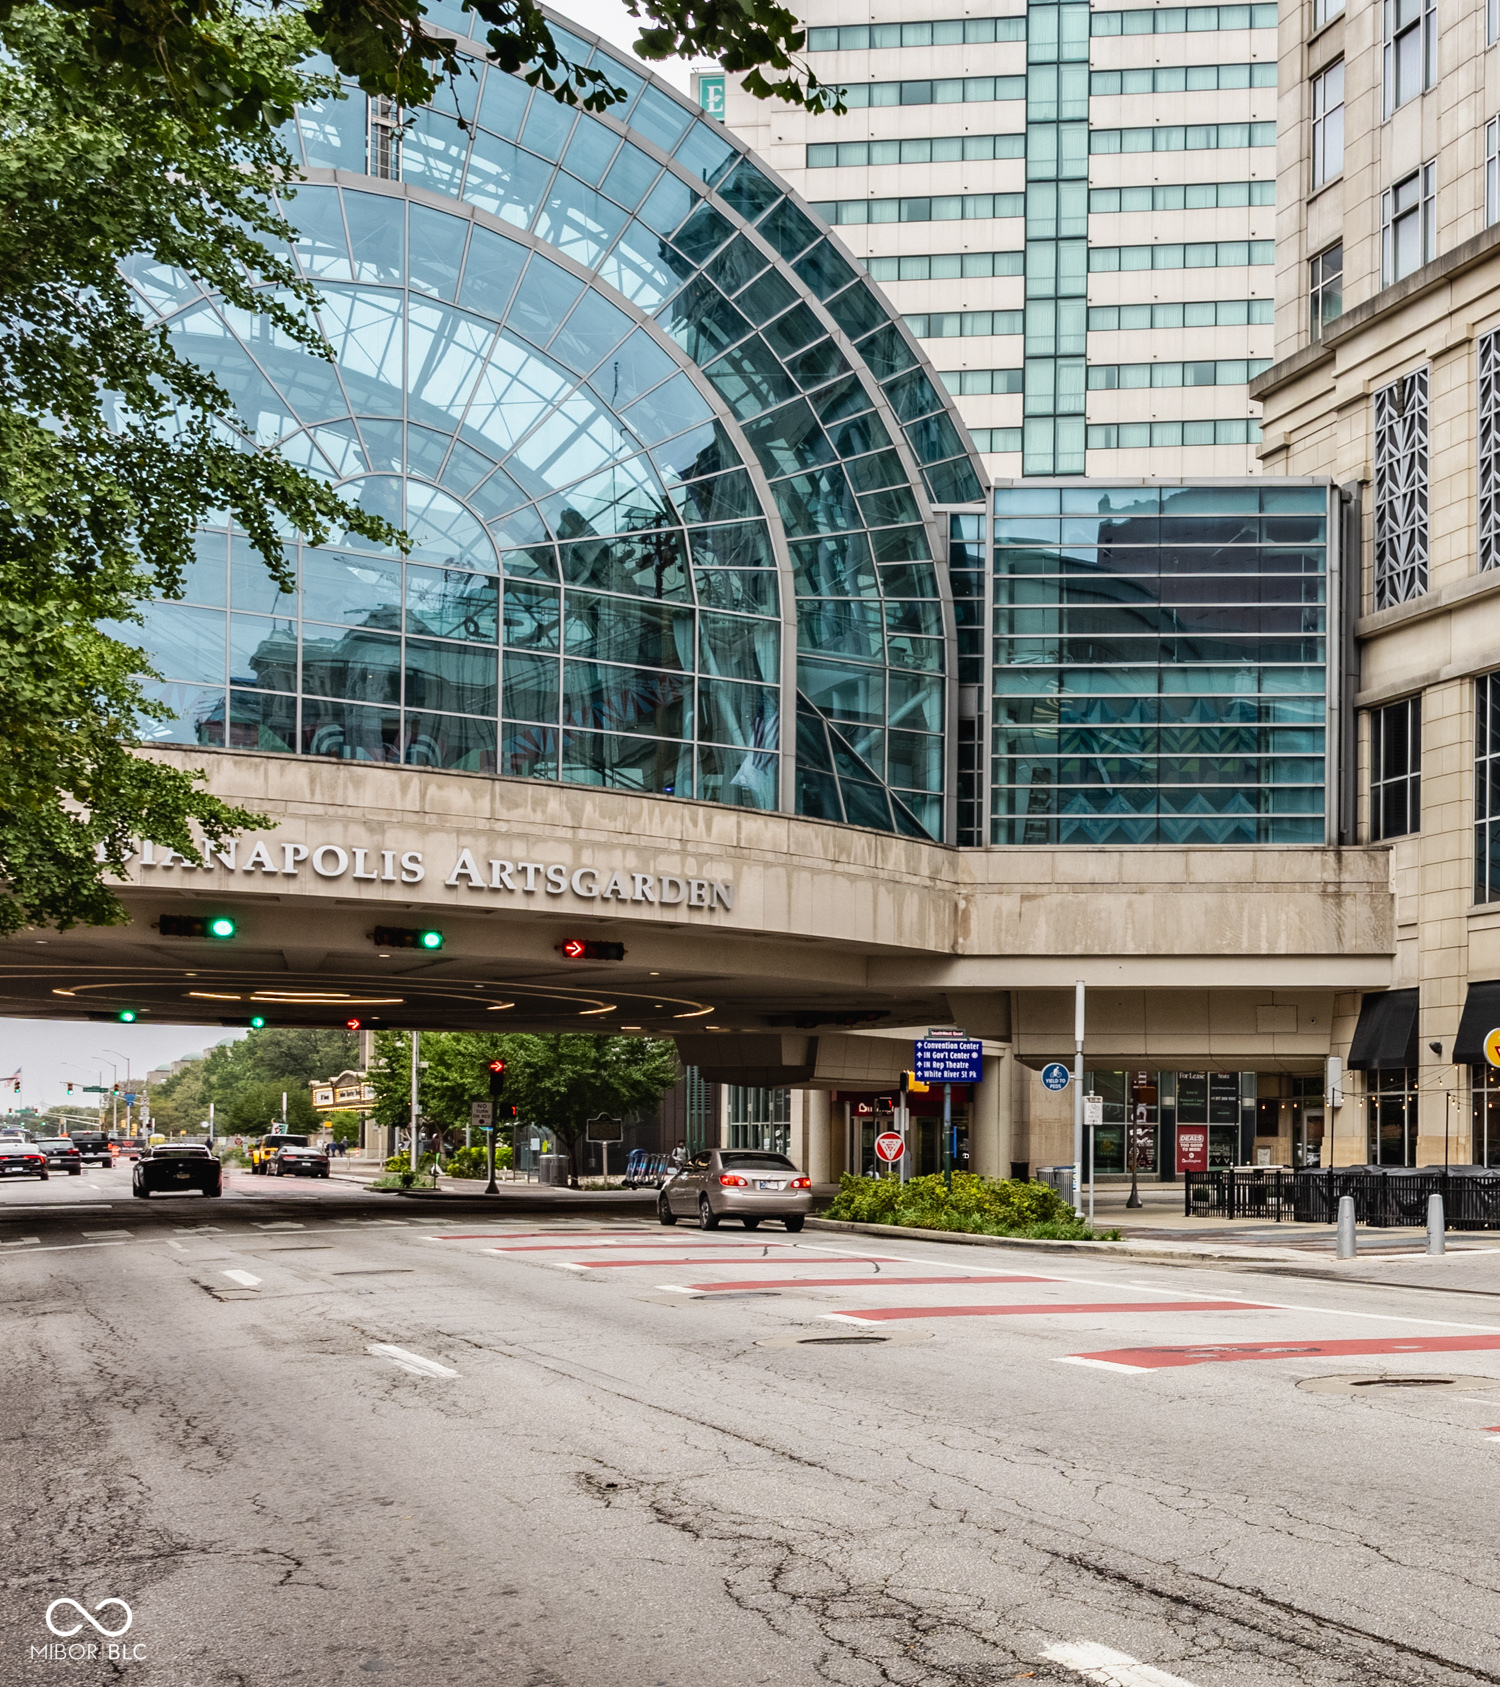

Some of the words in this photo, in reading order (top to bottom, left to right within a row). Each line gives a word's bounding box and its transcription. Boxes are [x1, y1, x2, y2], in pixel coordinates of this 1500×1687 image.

[445, 848, 735, 910] ARTSGARDEN
[923, 1041, 958, 1049] Convention
[959, 1042, 979, 1050] Center
[923, 1051, 931, 1059] IN
[932, 1051, 948, 1059] Gov't
[949, 1051, 970, 1059] Center
[932, 1061, 944, 1070] Rep
[945, 1061, 969, 1069] Theatre
[923, 1070, 942, 1078] White
[943, 1070, 960, 1078] River
[1189, 1072, 1205, 1080] Lease
